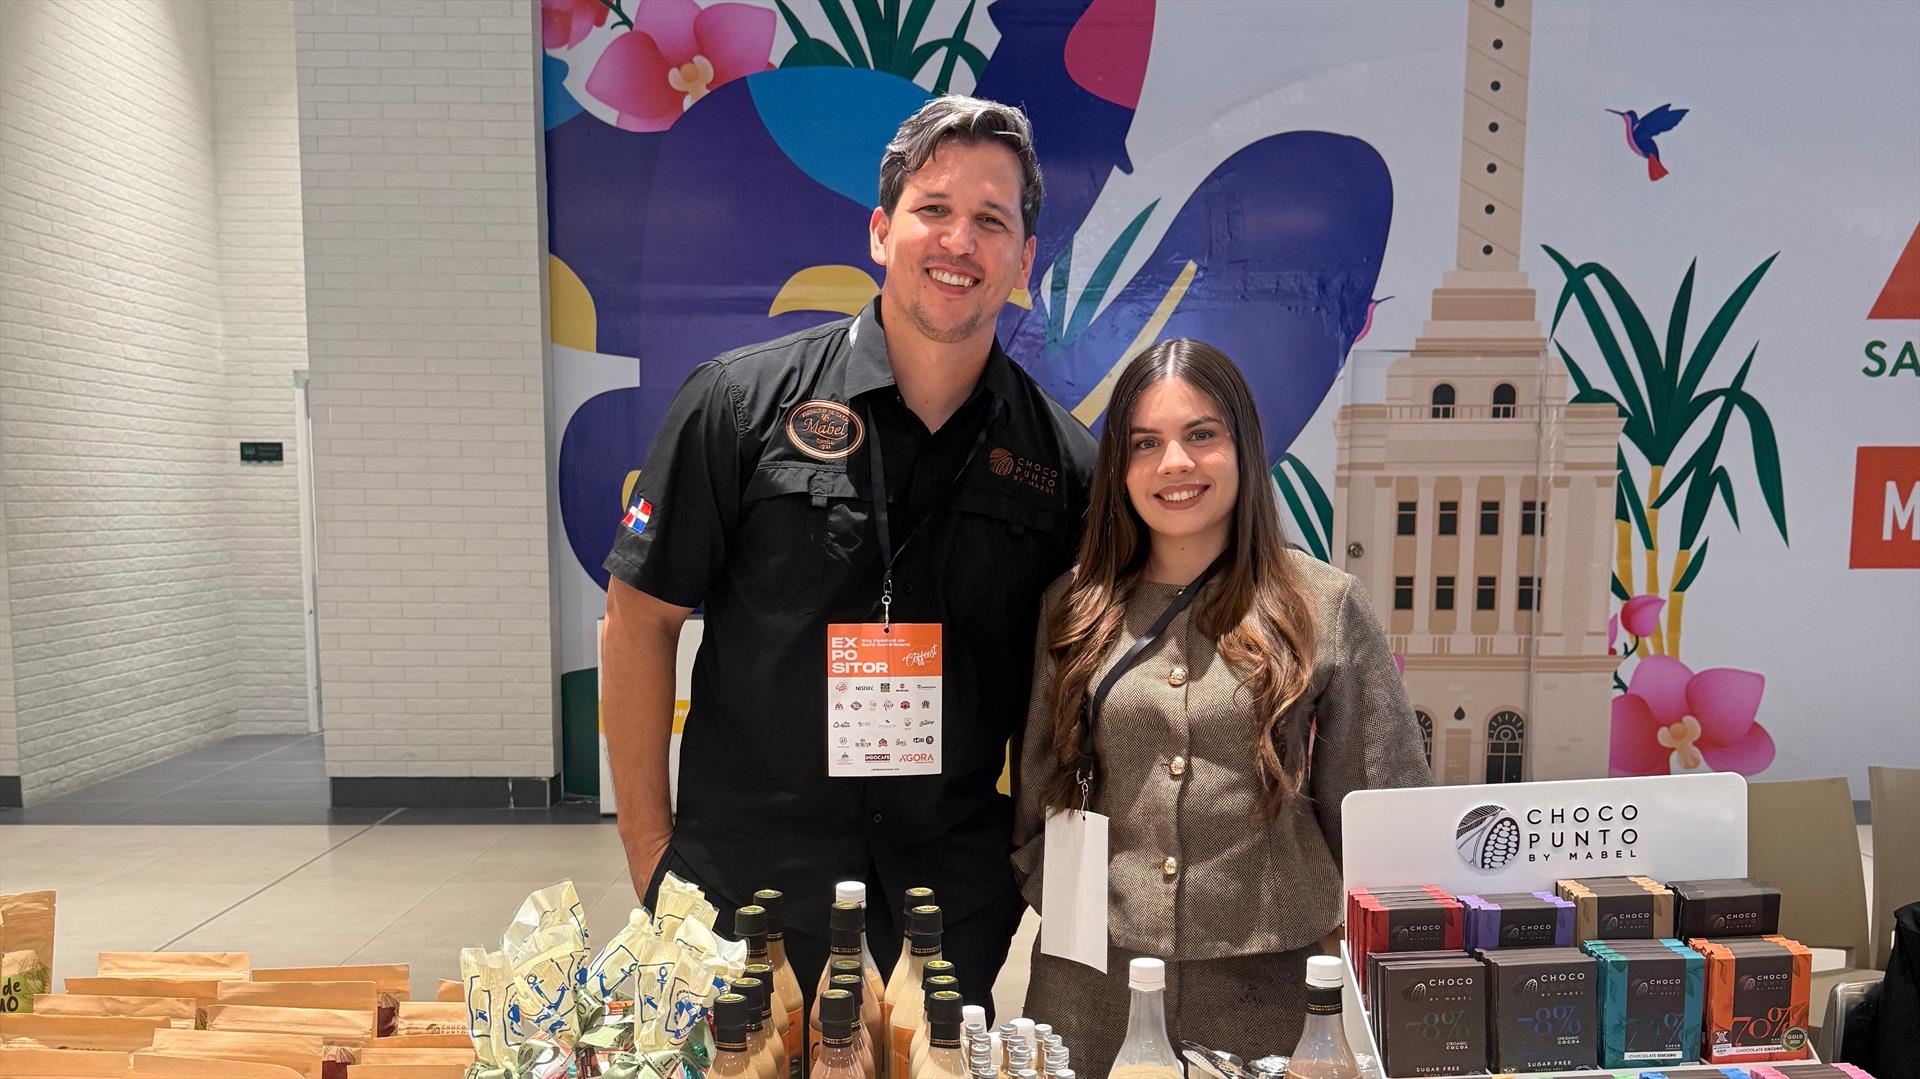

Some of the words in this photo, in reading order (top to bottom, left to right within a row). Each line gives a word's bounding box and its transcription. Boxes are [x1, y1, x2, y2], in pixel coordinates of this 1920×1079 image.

[1862, 340, 1920, 378] SA
[803, 418, 848, 436] Mabel
[1016, 466, 1055, 487] PUNTO
[1018, 458, 1058, 478] CHOCO
[832, 637, 858, 648] EX
[832, 650, 858, 660] PO
[832, 662, 888, 674] SITOR
[1527, 804, 1638, 824] CHOCO
[1529, 828, 1638, 848] PUNTO
[1528, 853, 1550, 862] BY
[1569, 850, 1636, 860] MABEL
[1429, 978, 1472, 986] CHOCO
[1540, 972, 1585, 982] CHOCO
[2, 978, 21, 996] de
[1733, 1006, 1790, 1047] 70%
